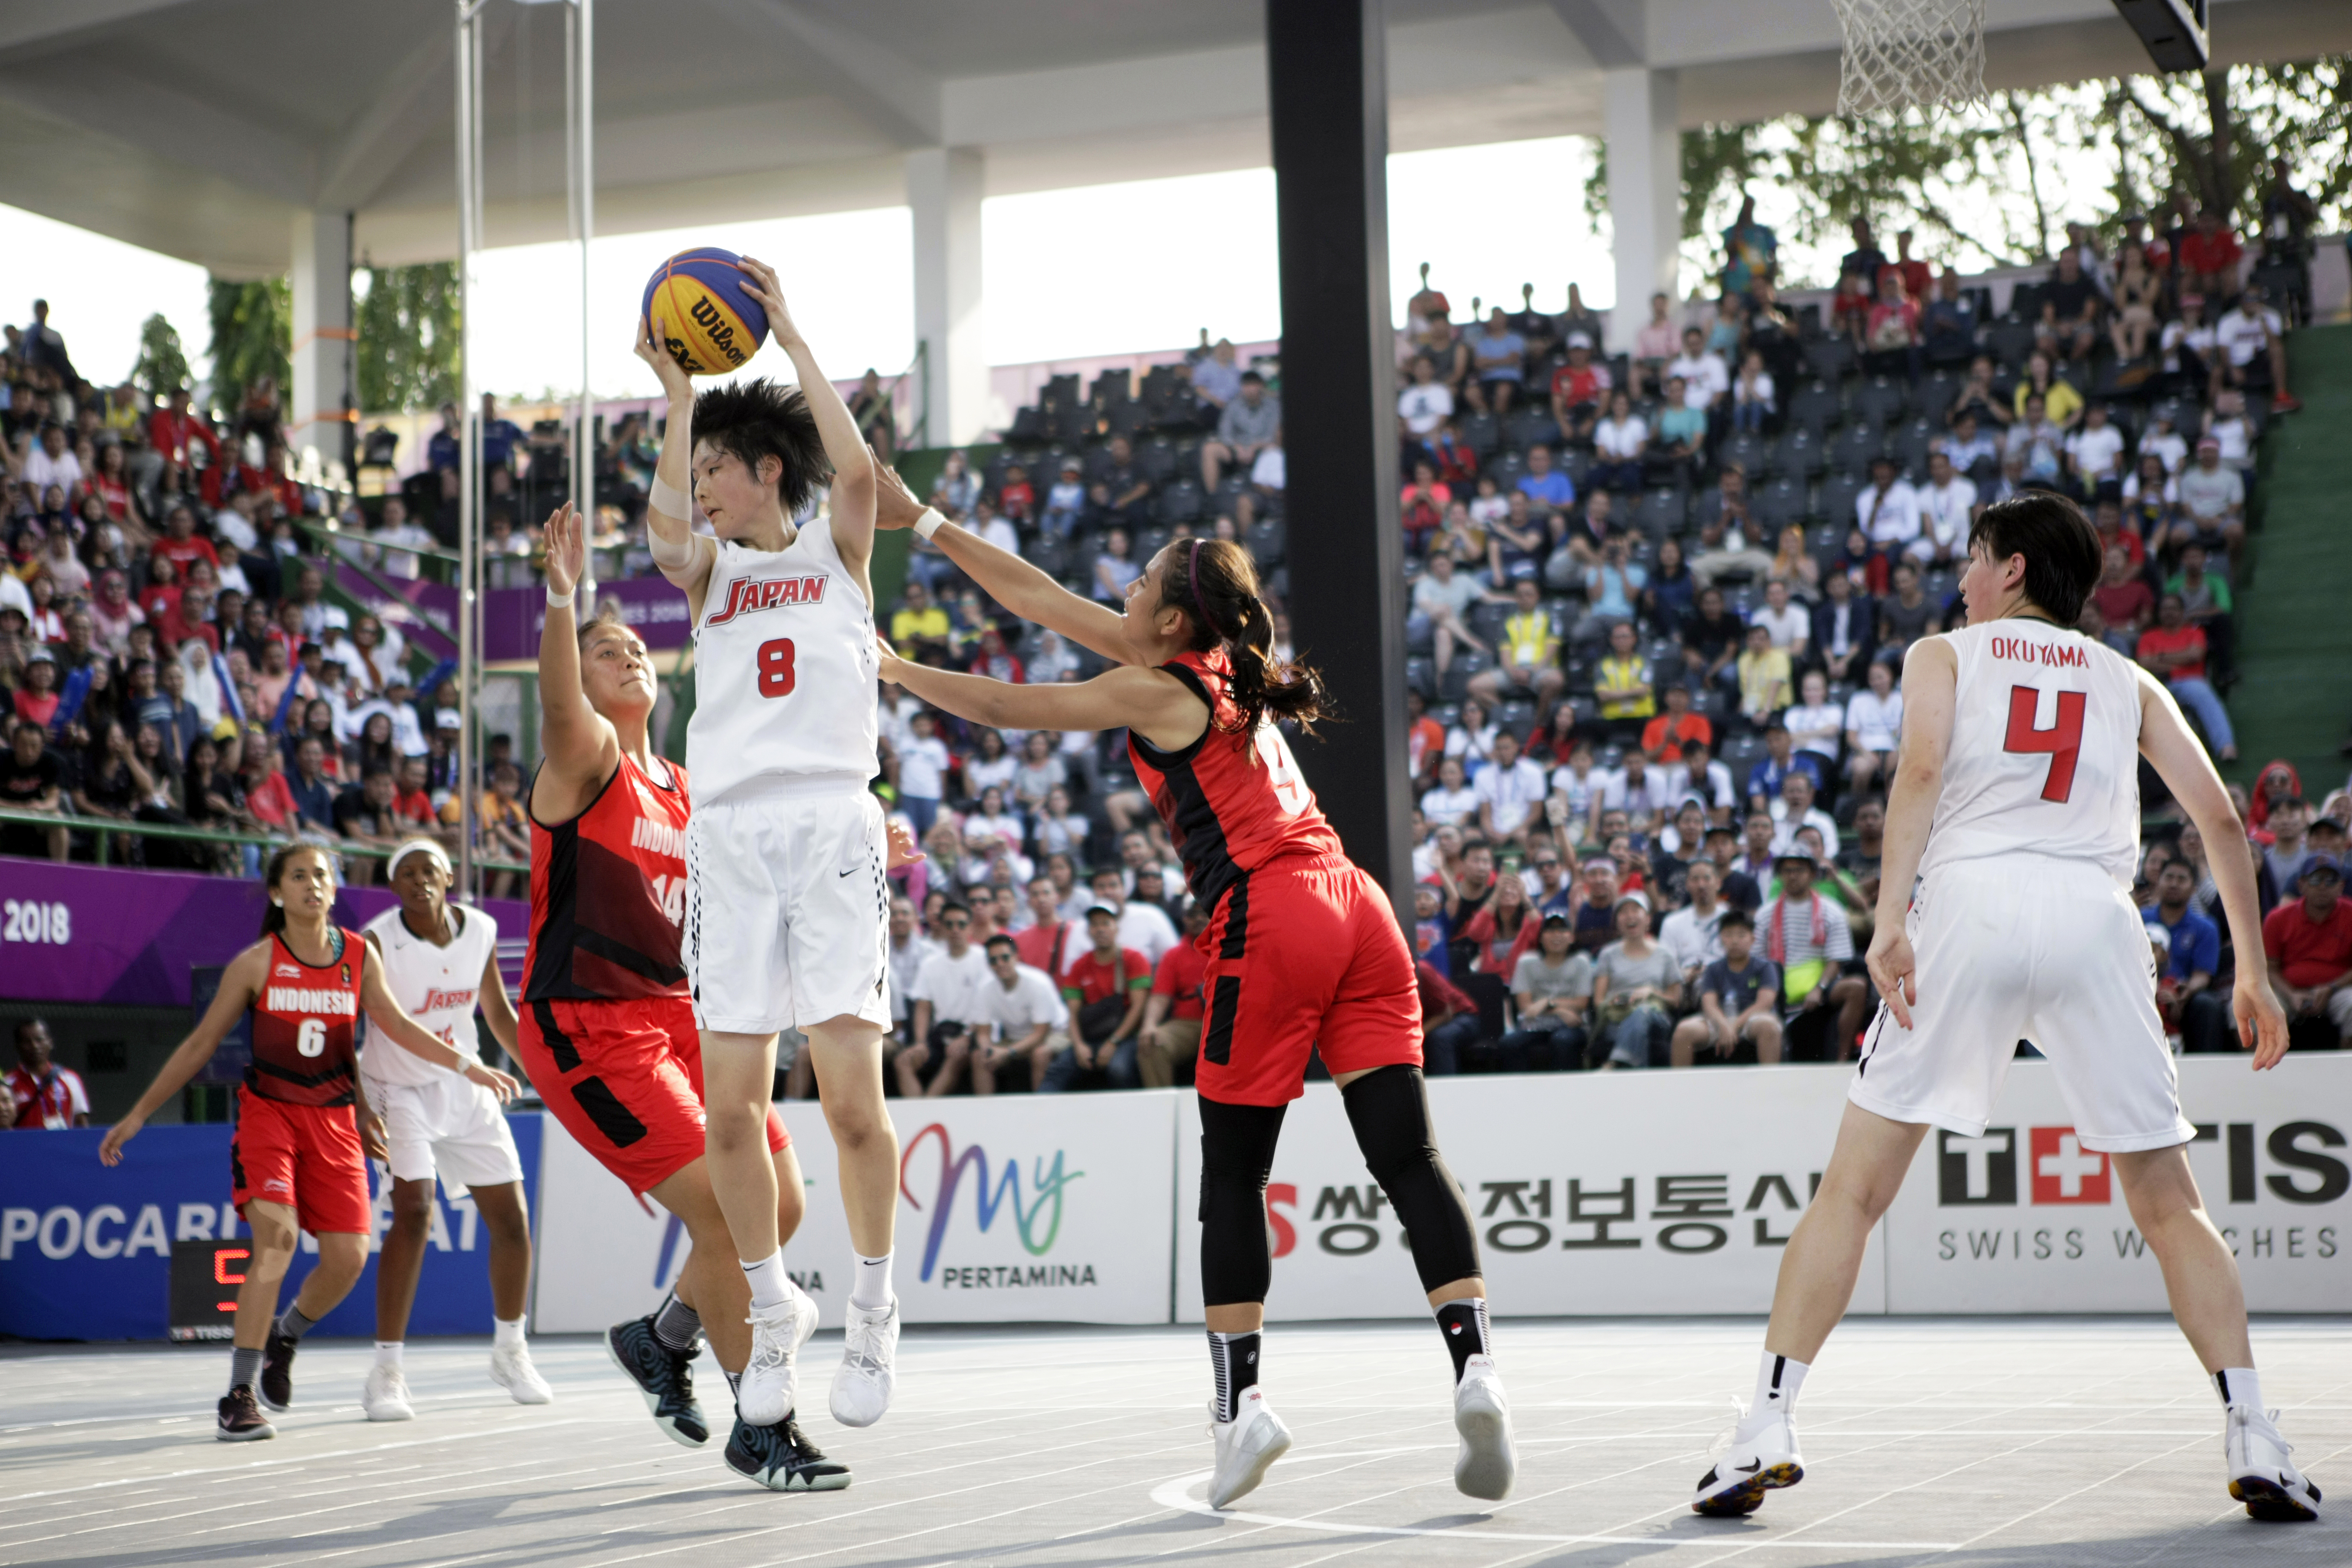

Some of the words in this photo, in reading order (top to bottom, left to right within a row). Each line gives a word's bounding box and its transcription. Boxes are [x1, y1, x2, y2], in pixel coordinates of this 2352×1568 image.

[691, 295, 747, 366] Wilson
[705, 575, 829, 628] JAPAN
[757, 638, 795, 699] 8
[1991, 637, 2090, 669] OKUYAMA
[2003, 684, 2087, 804] 4
[3, 898, 71, 945] 2018
[652, 874, 688, 928] 14
[267, 987, 355, 1016] INDONESIA
[297, 1017, 327, 1058] 6
[2187, 1120, 2350, 1207] IS
[0, 1201, 240, 1260] POCARI
[1310, 1172, 1823, 1257] 쌍정보통신
[1938, 1229, 2083, 1260] SWISS
[2113, 1227, 2338, 1259] WCHES
[942, 1264, 1098, 1290] PERTAMINA
